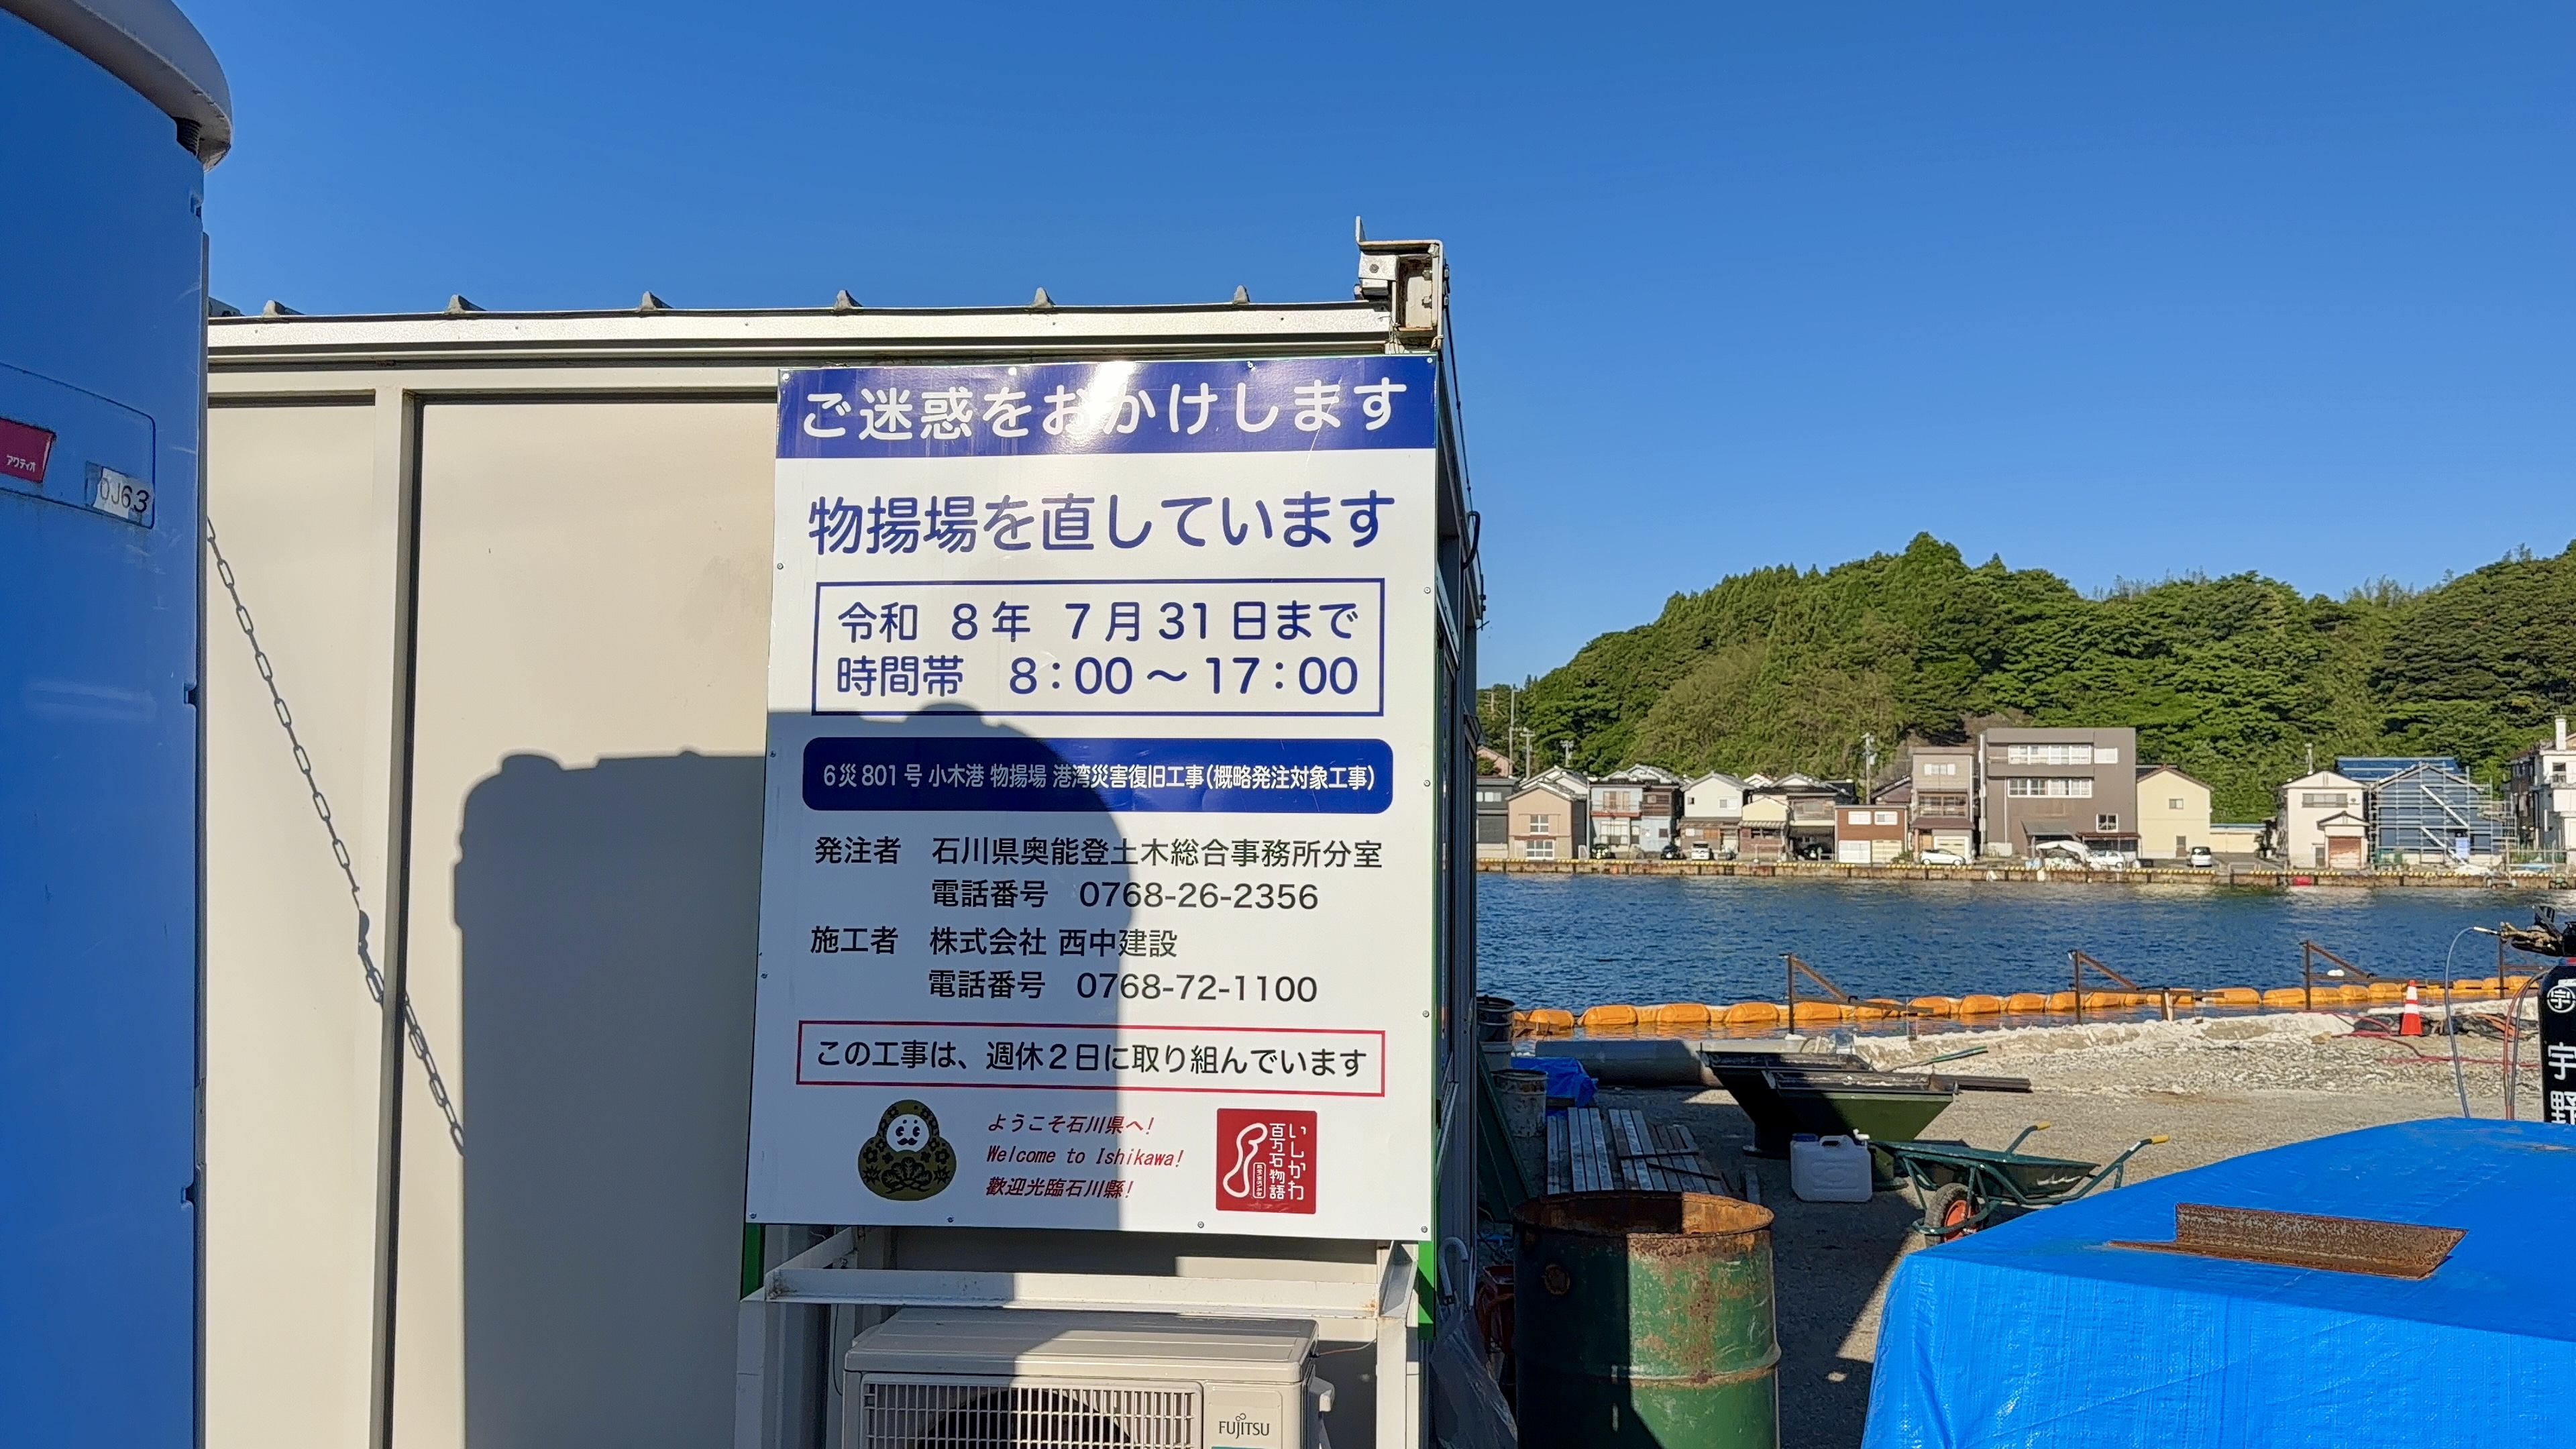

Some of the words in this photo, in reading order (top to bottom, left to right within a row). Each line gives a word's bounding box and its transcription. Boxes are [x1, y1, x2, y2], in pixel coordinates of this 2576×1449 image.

[802, 377, 1407, 439] ご迷惑をおかけします
[808, 490, 1395, 555] 物揚場を直しています
[837, 601, 918, 643] 令和
[836, 655, 965, 697] 時間帯
[814, 835, 902, 865] 発注者
[932, 836, 1383, 869] 石川県奥能登土木総合事務所分室
[931, 878, 1049, 908] 電話番号
[1079, 881, 1319, 910] 0768-26-2356
[810, 926, 899, 955] 施工者
[929, 926, 1047, 957] 株式会社
[1059, 928, 1178, 959] 西中建設
[928, 969, 1046, 999] 電話番号
[1076, 972, 1318, 1003] 0768-72-1100
[986, 1145, 1057, 1163] Welcome
[1067, 1148, 1086, 1164] to
[1095, 1148, 1185, 1168] Ishikawa!
[1269, 1123, 1286, 1199] 百万石物語
[1287, 1123, 1307, 1200] いしかわ
[1218, 1413, 1270, 1440] FUJITSU
